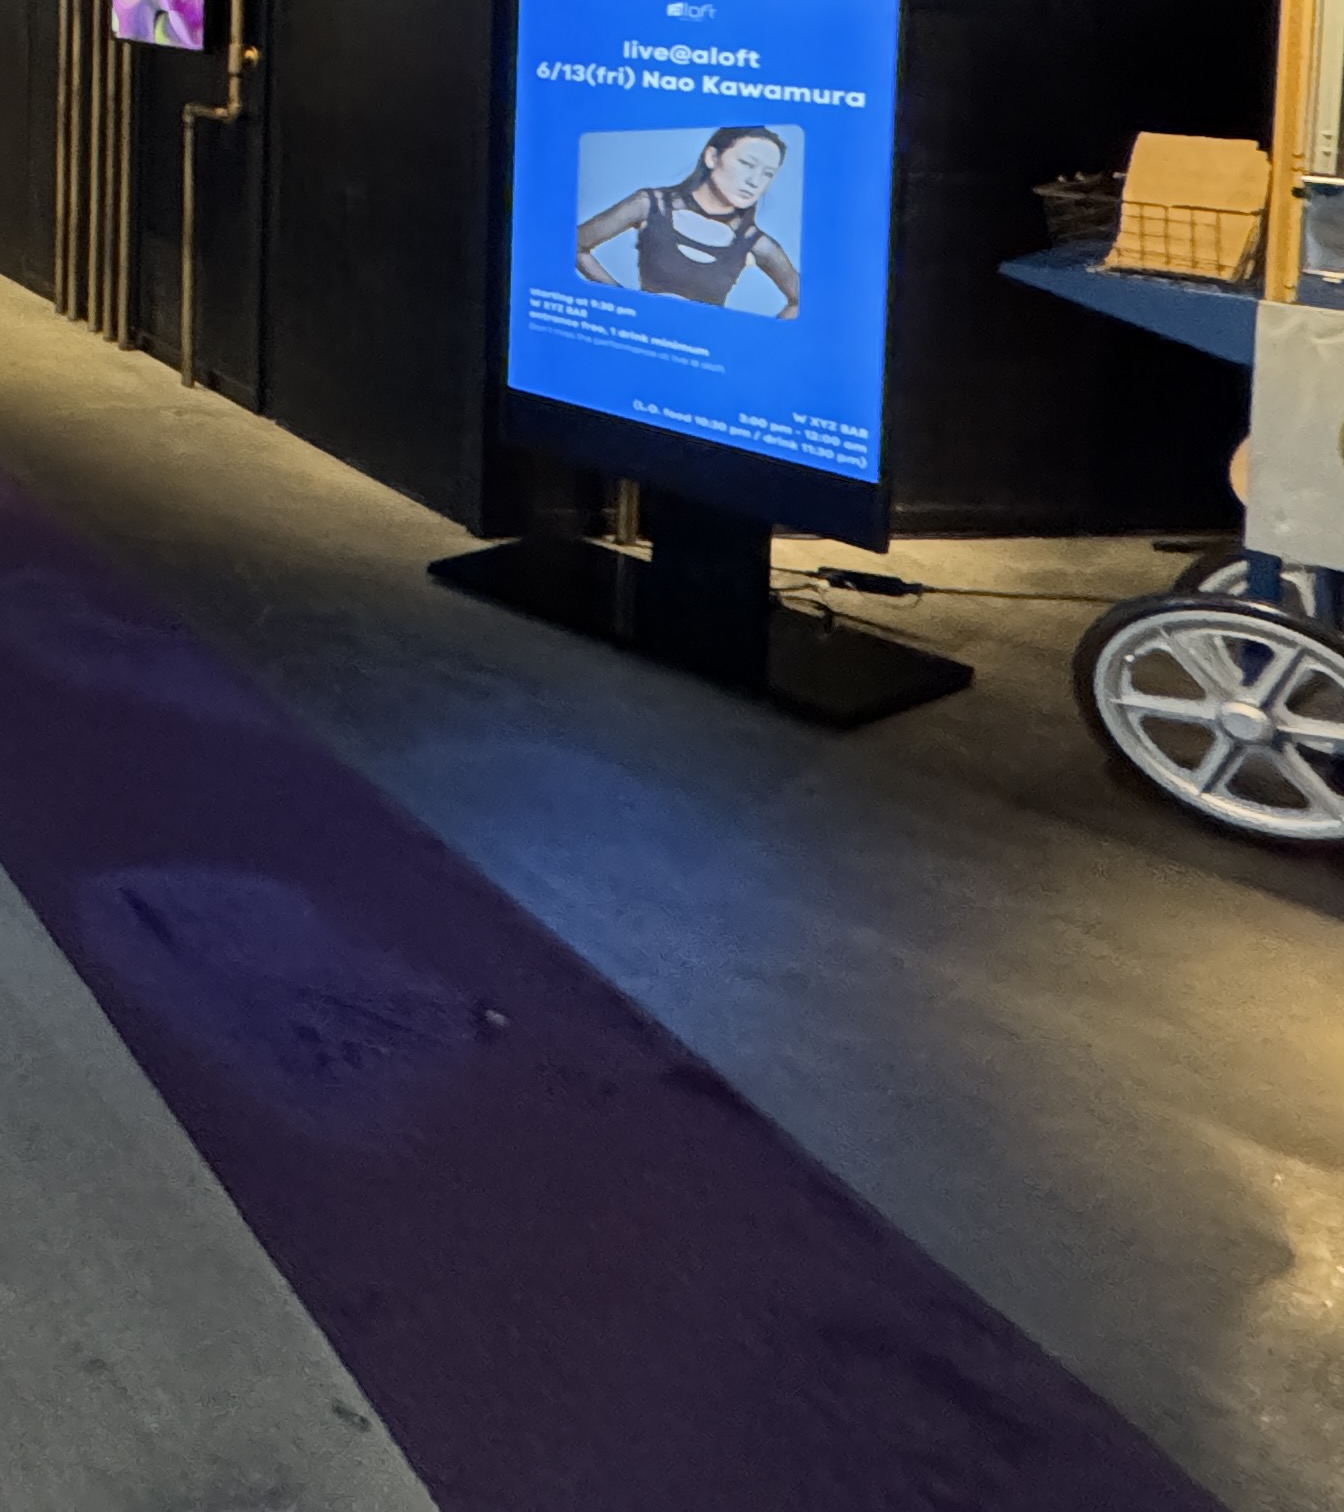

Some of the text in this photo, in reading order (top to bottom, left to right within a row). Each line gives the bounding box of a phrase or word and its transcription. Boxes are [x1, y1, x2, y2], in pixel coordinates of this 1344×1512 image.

[622, 40, 761, 69] live@aloft
[536, 61, 867, 108] 6/13(fri) Nao Kawamura
[809, 416, 837, 431] XYZ
[839, 424, 869, 439] BAR
